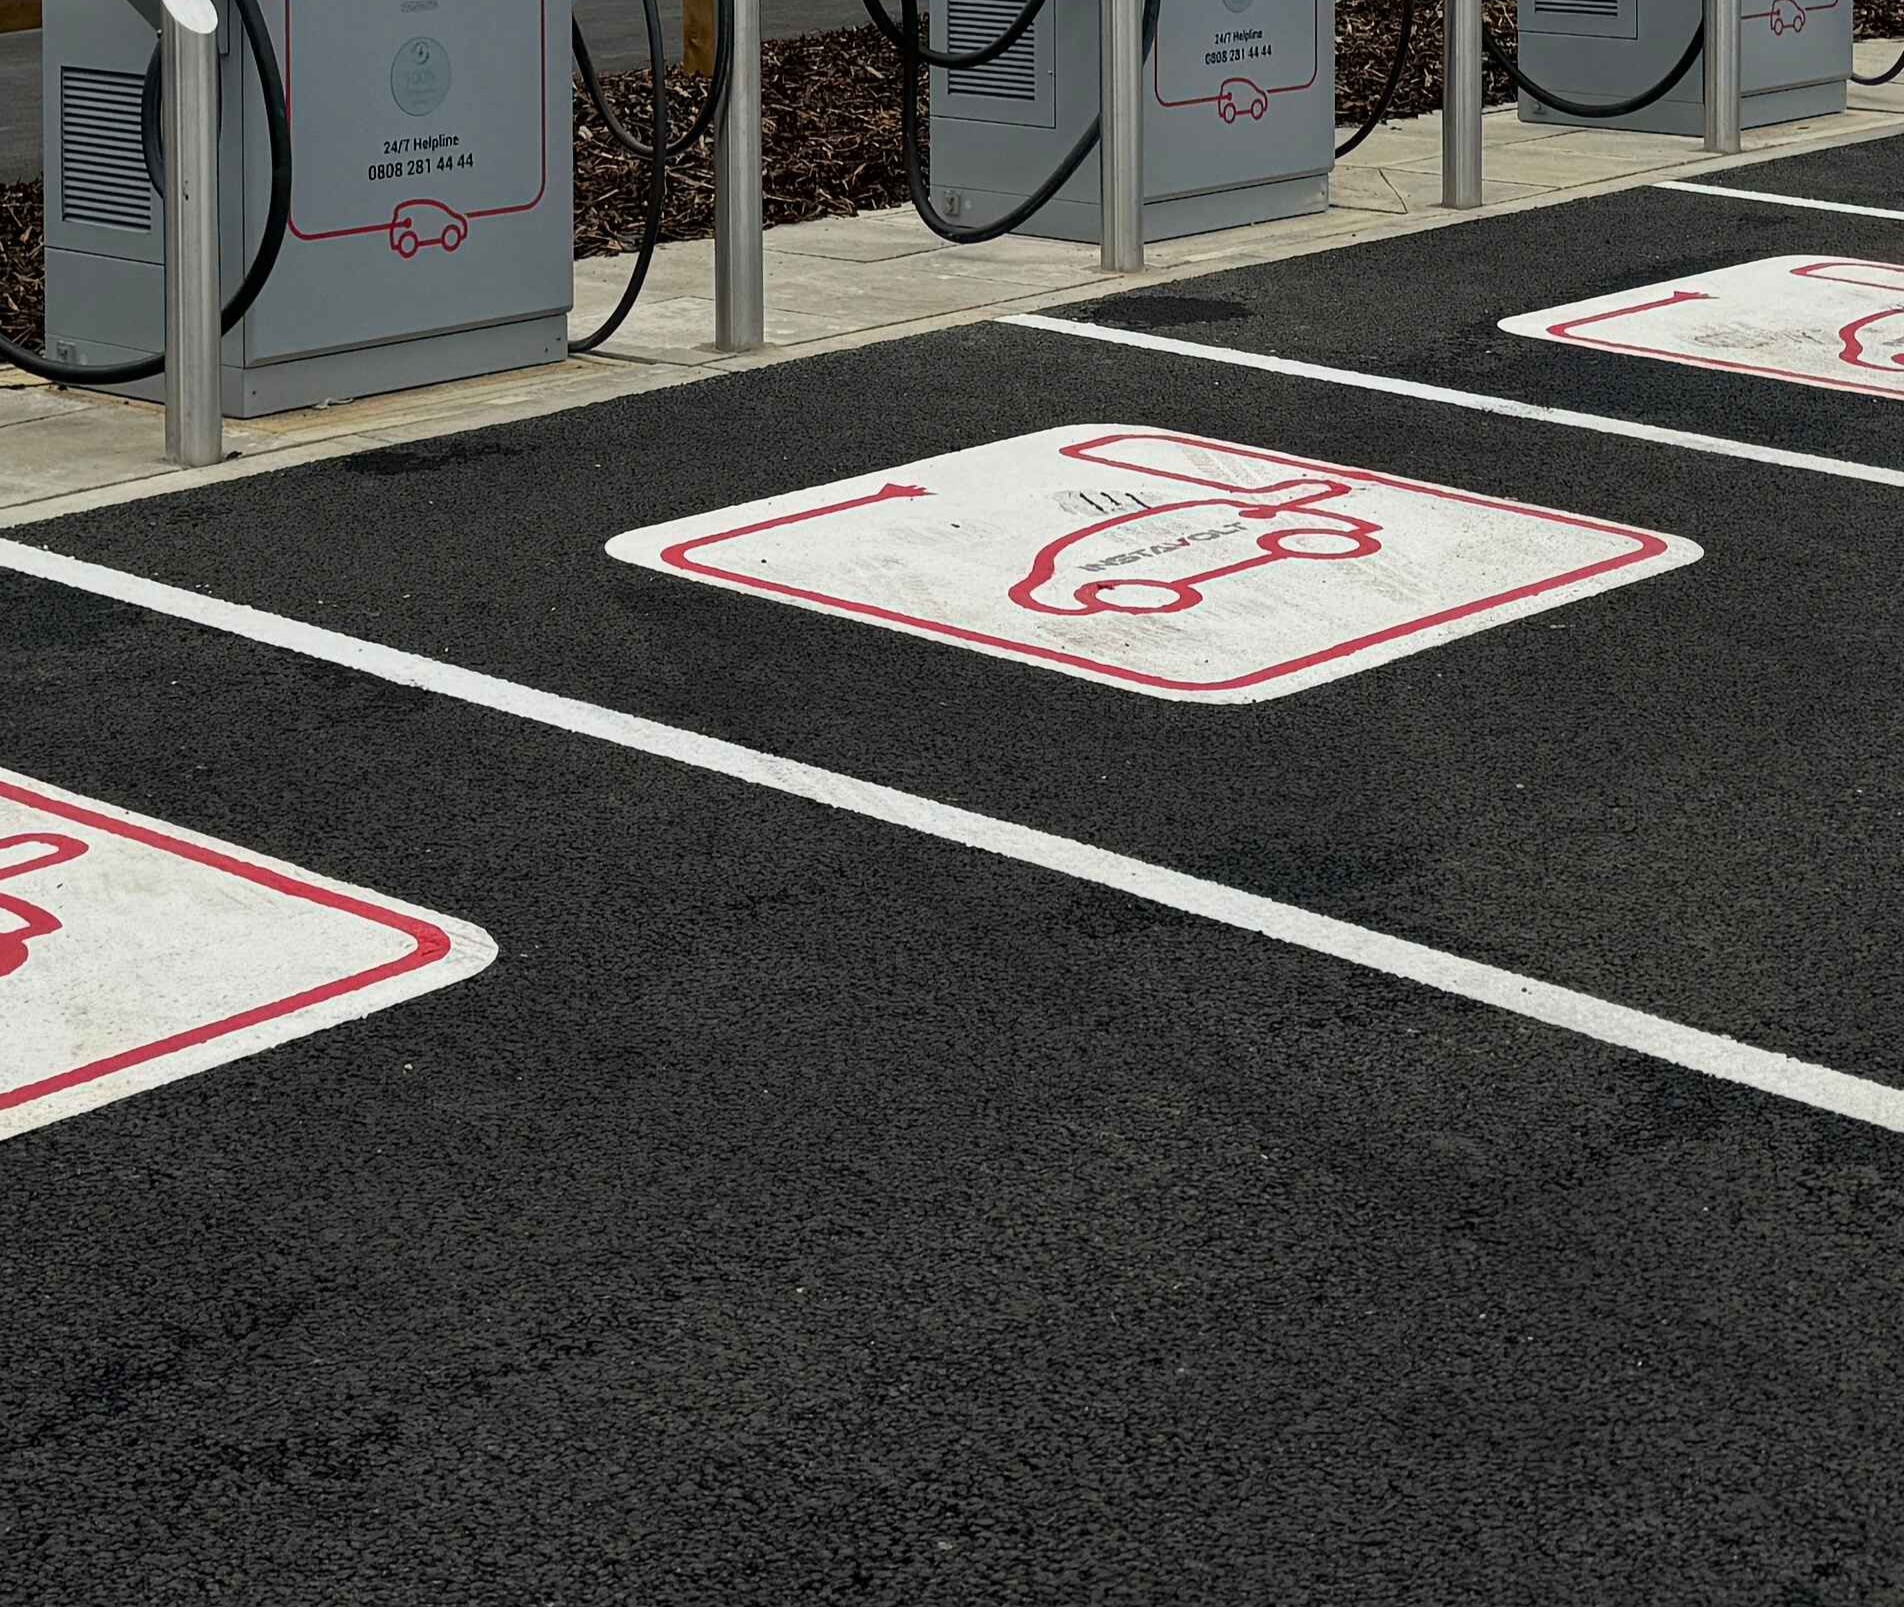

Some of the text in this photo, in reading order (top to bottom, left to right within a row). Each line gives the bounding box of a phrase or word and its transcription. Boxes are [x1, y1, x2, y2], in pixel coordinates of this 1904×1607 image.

[383, 132, 461, 155] 24/7 Helpline
[368, 152, 474, 181] 0808 281 44 44
[1078, 520, 1250, 573] INSTAVOLT
